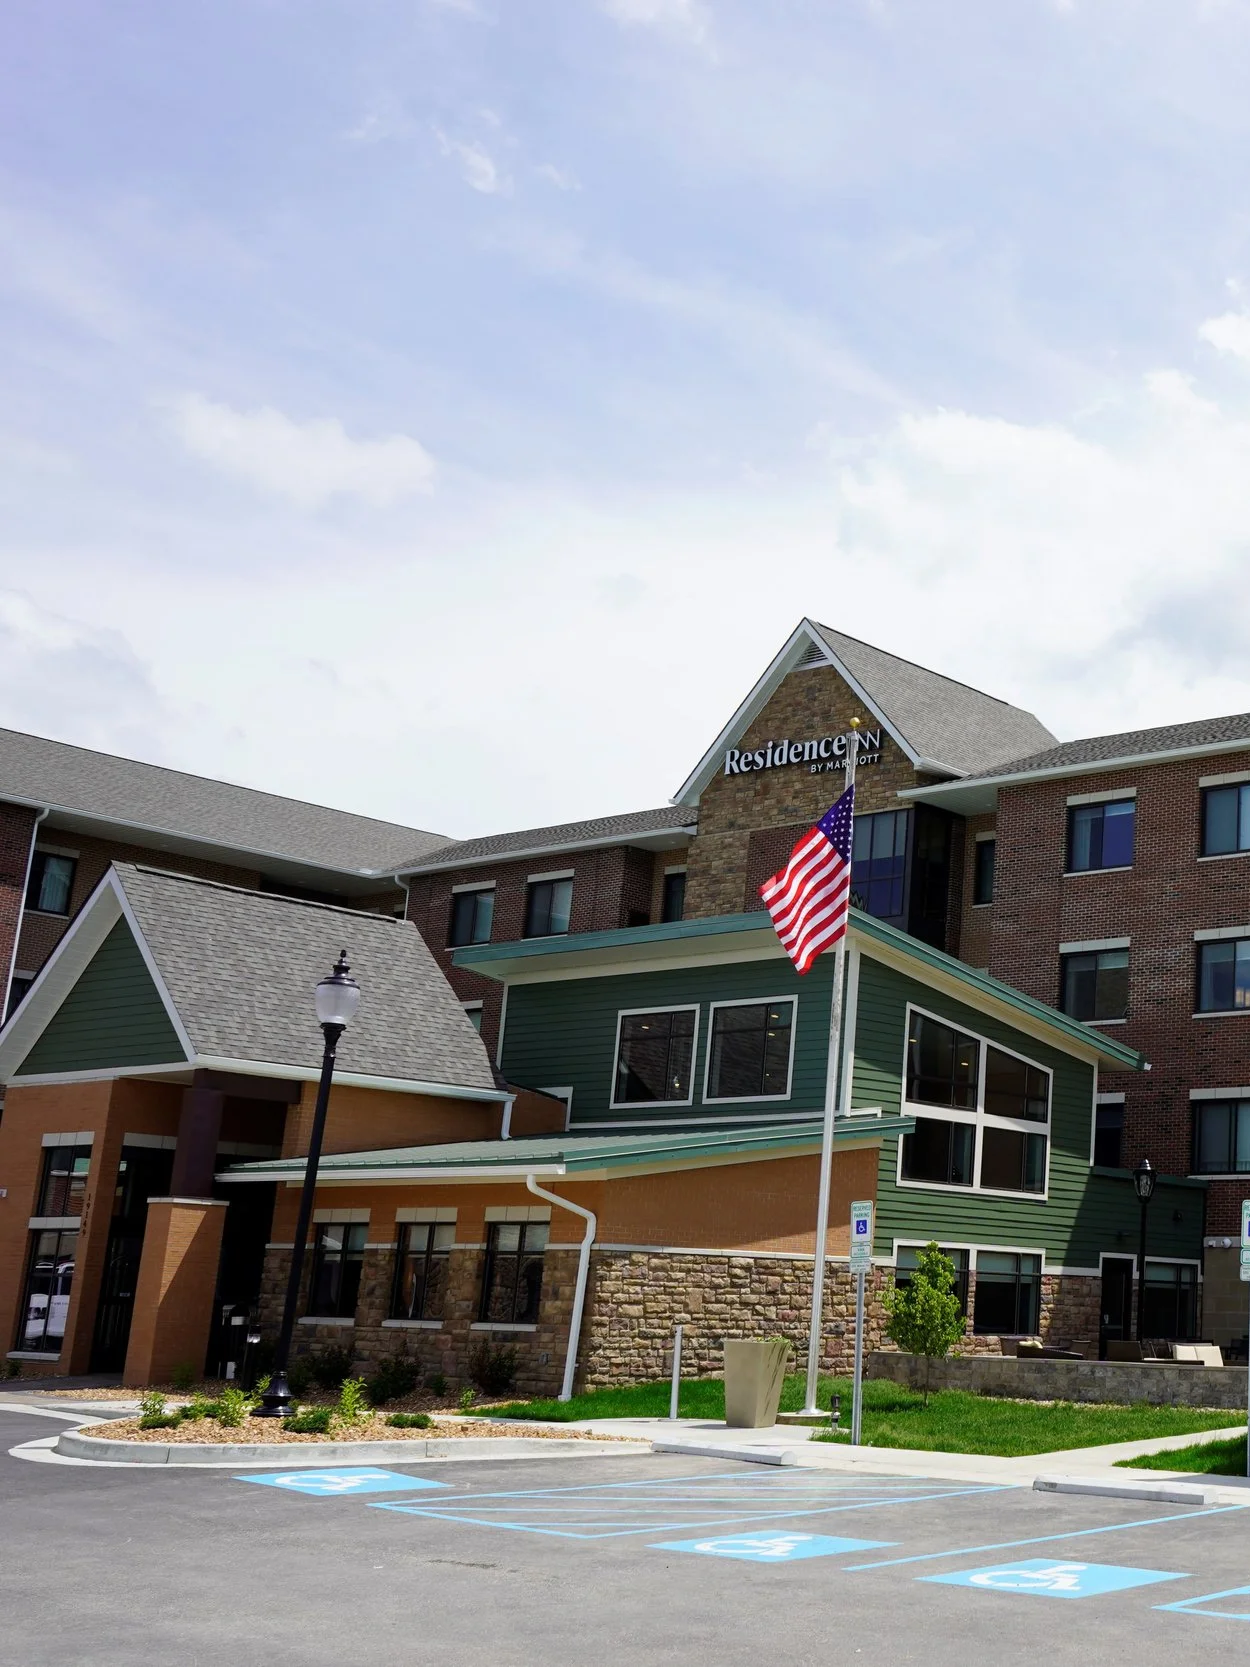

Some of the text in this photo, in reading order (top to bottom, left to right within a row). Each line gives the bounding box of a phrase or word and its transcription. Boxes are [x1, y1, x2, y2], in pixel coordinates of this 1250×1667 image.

[724, 729, 880, 775] Residence NN
[811, 753, 880, 774] BY MARIOTT
